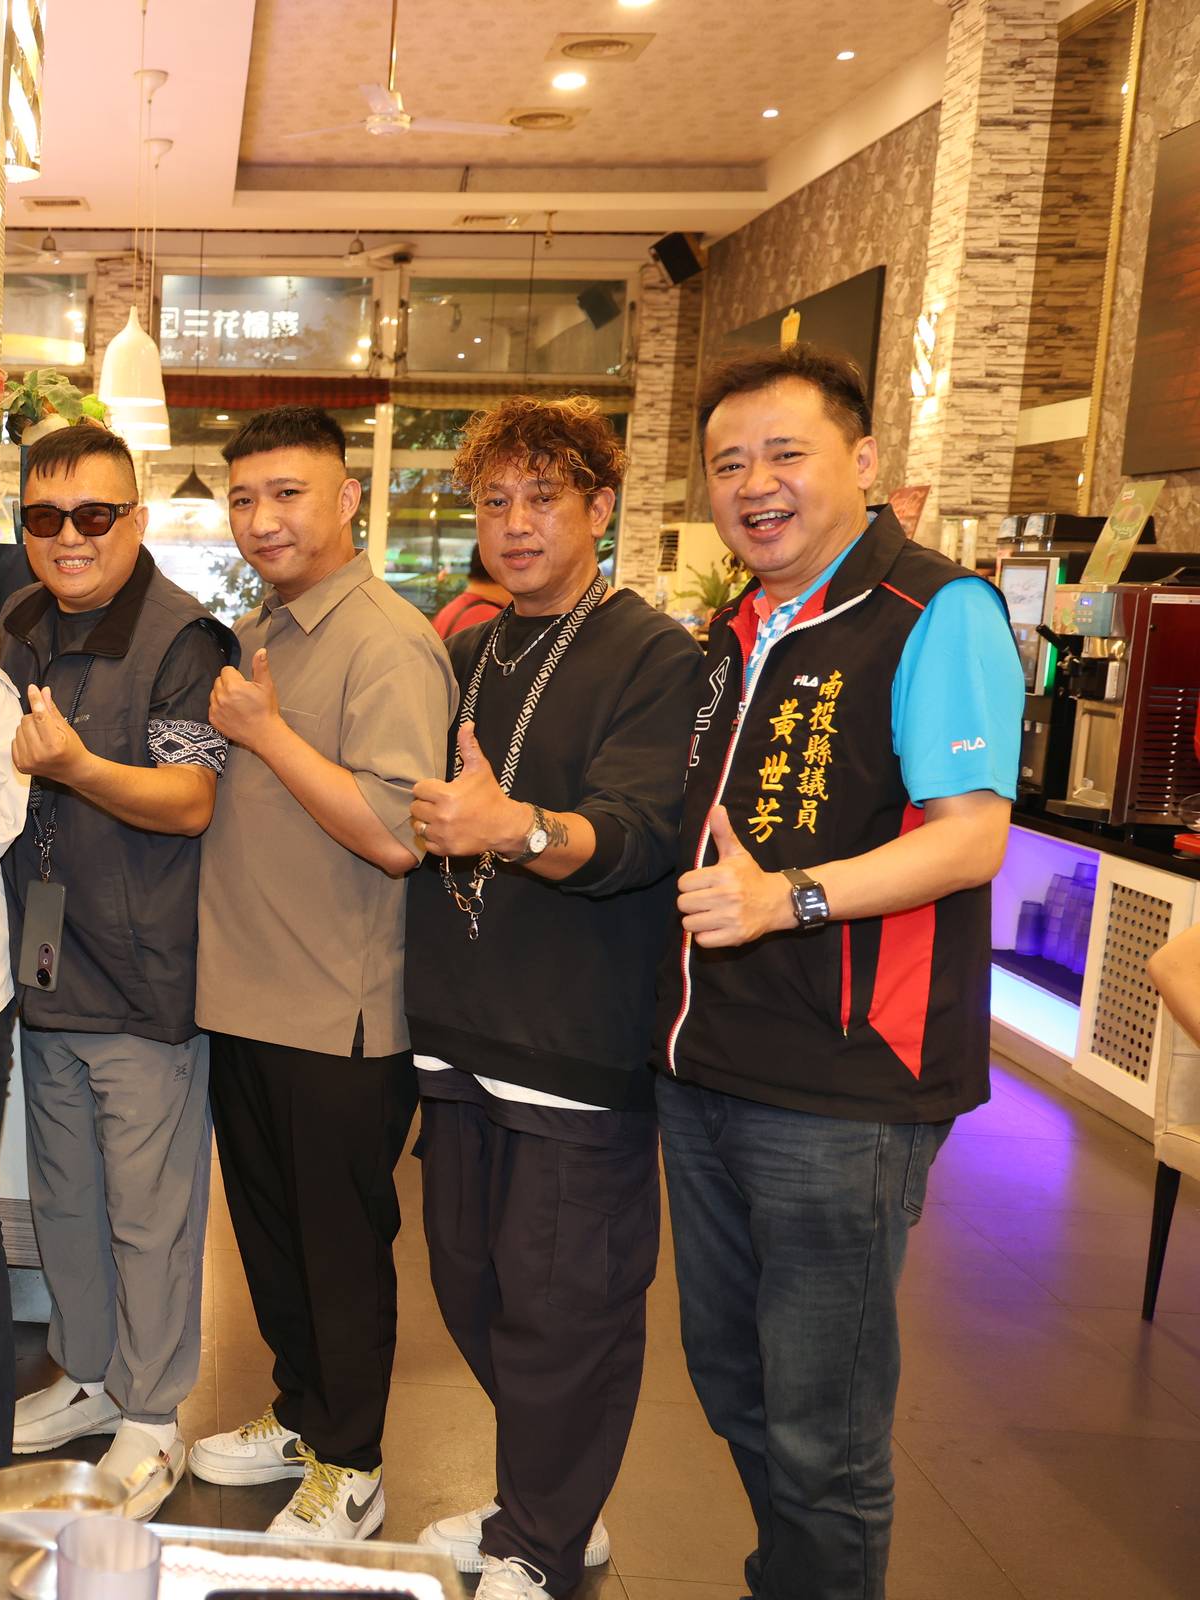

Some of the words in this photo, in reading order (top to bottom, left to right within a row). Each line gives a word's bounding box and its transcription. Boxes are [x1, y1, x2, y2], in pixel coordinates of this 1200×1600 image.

[793, 674, 819, 688] FILA
[747, 698, 804, 844] 黃世芳
[792, 669, 844, 835] 南投縣議員
[952, 736, 987, 754] FILA
